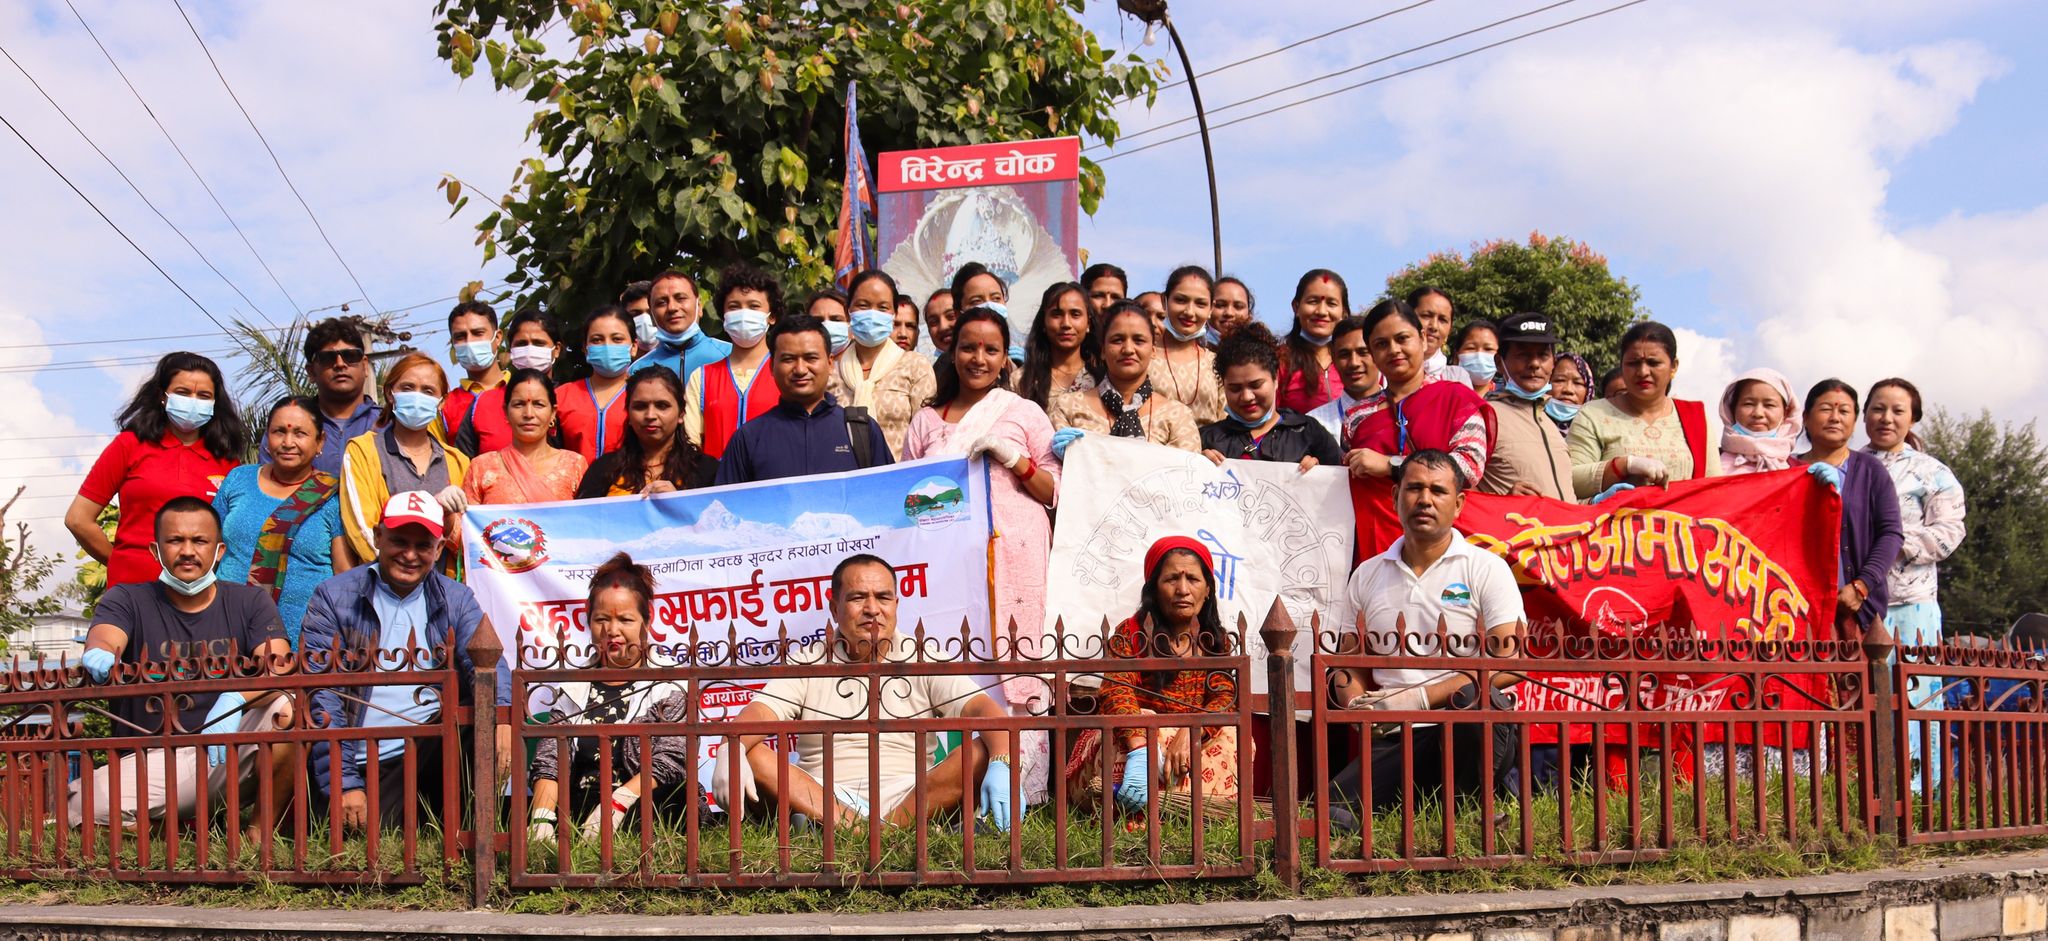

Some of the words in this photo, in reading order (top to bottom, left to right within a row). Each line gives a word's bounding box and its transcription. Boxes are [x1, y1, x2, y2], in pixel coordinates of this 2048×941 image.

[901, 155, 986, 184] विरेन्द्र
[994, 149, 1057, 176] चोक
[1520, 321, 1547, 331] OBEY
[708, 554, 743, 569] स्वच्छ
[747, 548, 784, 567] सुन्दर
[787, 542, 832, 561] हराभरा
